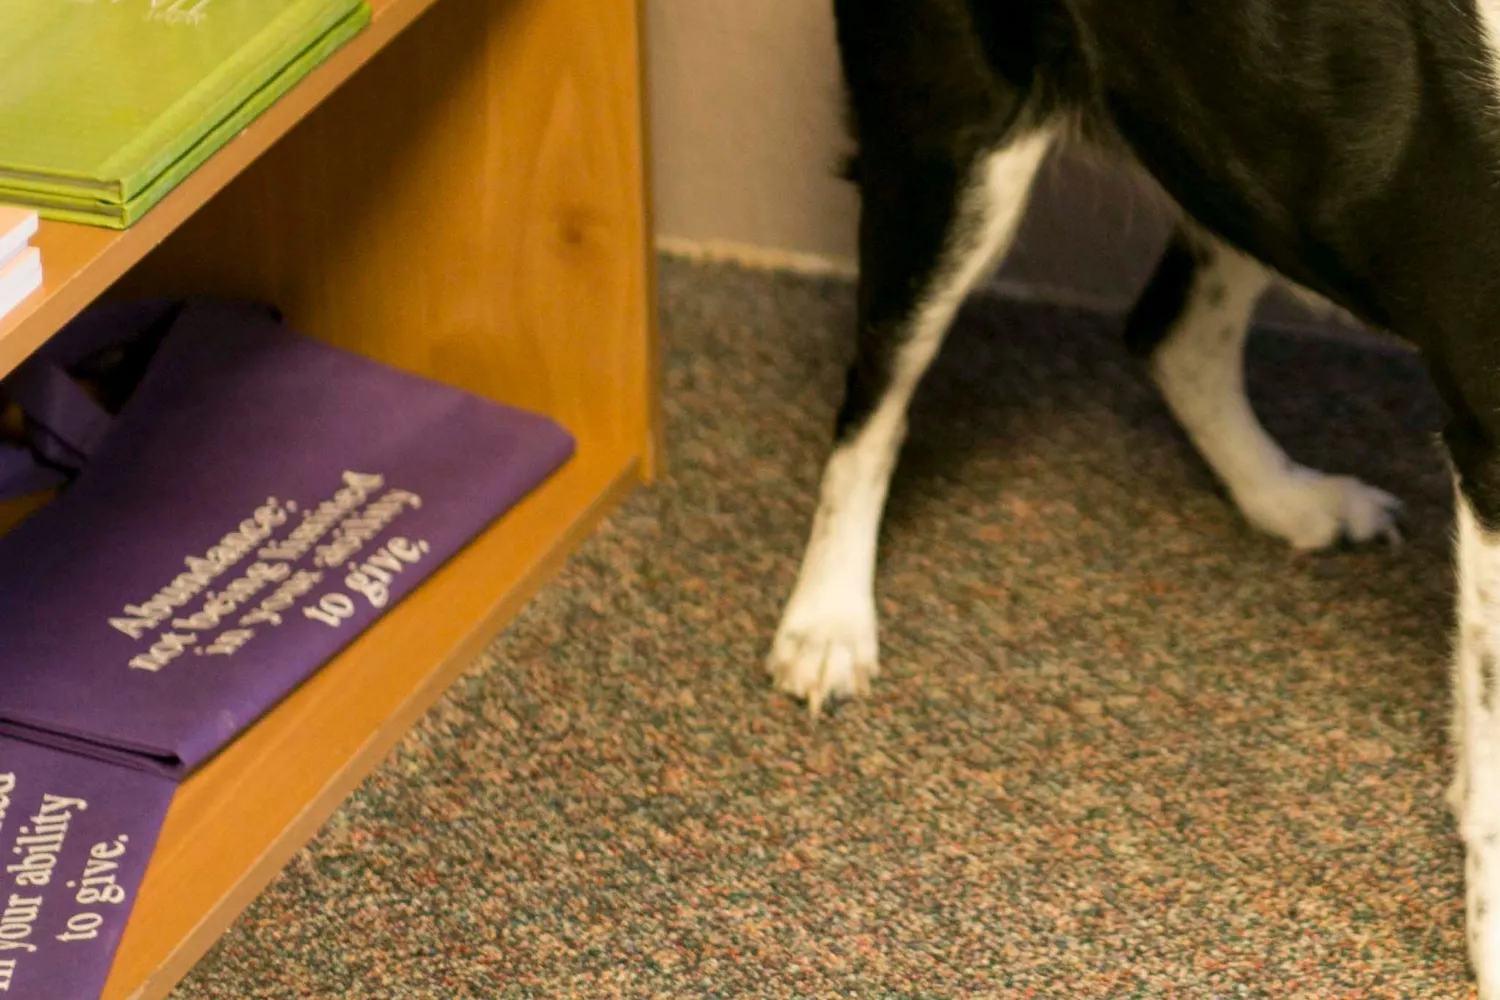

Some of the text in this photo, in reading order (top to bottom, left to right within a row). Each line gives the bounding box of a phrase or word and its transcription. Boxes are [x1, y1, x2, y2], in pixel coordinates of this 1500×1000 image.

[107, 496, 297, 639] Abundance:
[128, 470, 384, 672] not being limited
[240, 568, 324, 626] your
[313, 488, 423, 568] ability
[302, 536, 431, 629] to give.
[6, 792, 89, 887] ability
[55, 833, 130, 943] to give.
